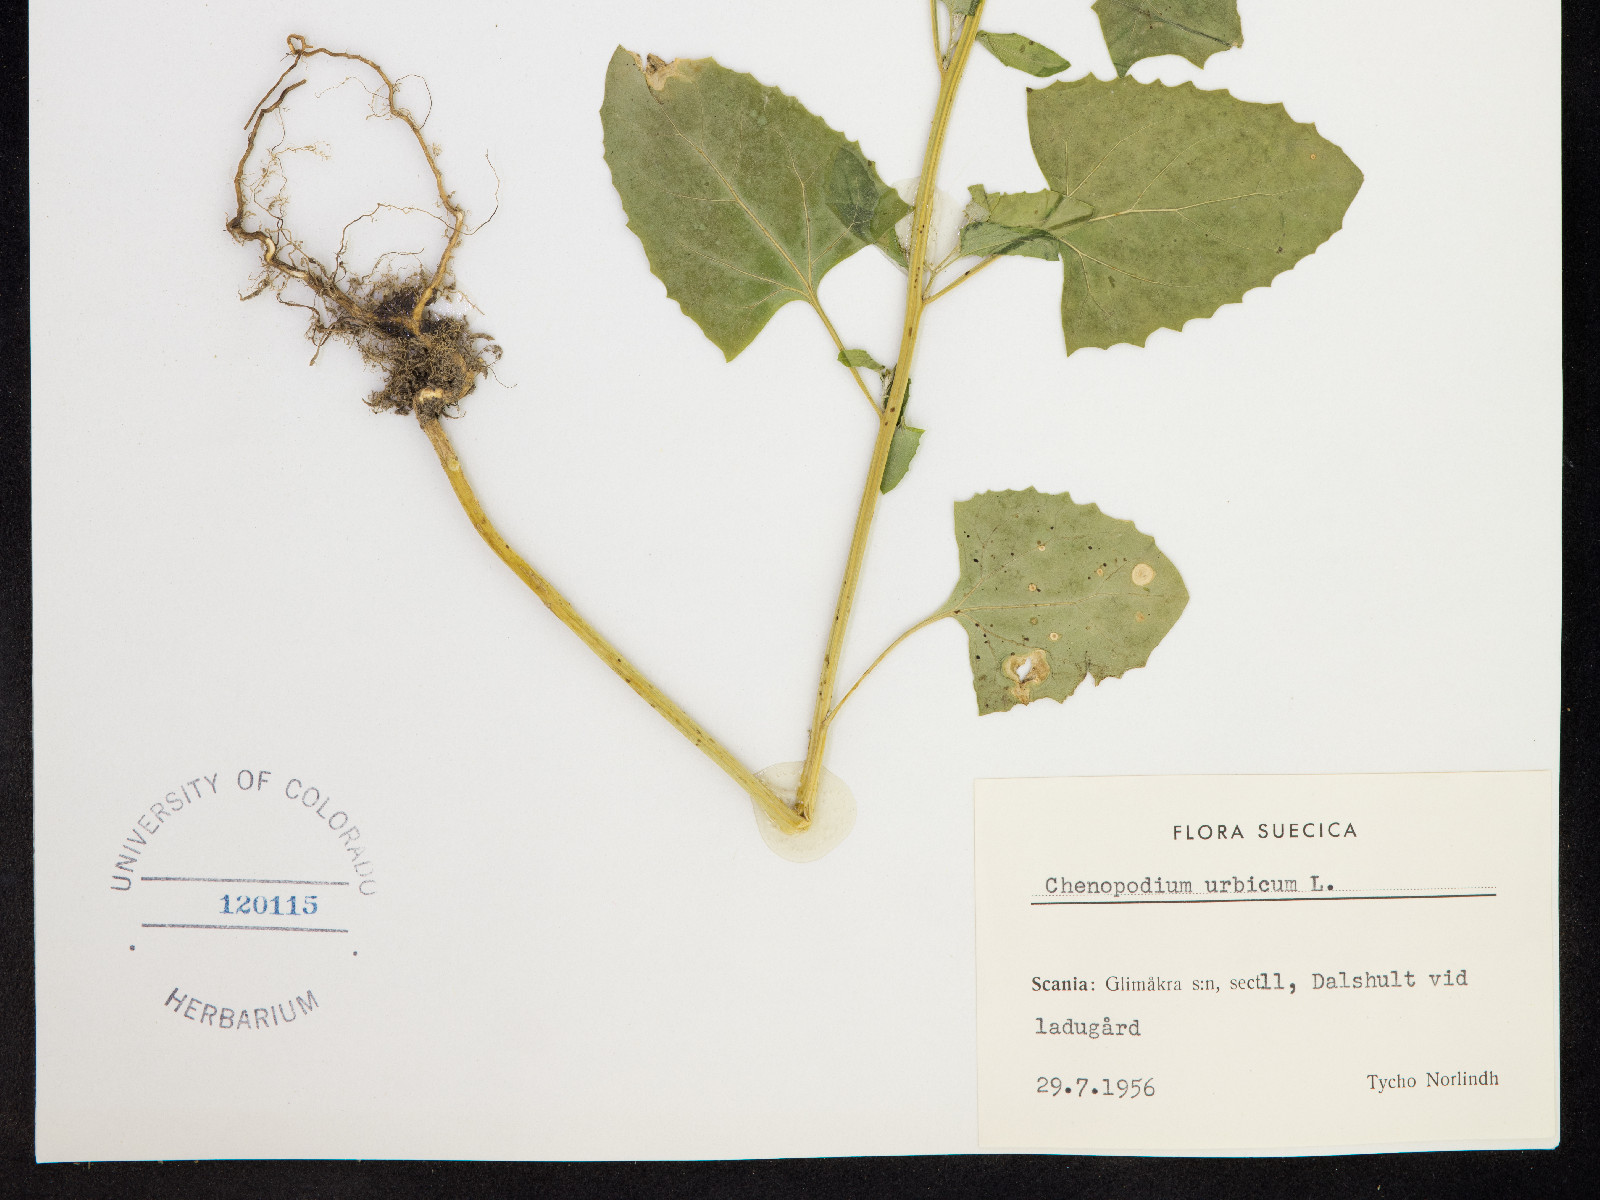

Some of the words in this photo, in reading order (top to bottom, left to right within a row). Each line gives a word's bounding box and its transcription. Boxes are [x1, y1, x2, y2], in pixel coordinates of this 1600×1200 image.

[110, 773, 218, 891] UNIVERSITY
[237, 769, 272, 791] OF
[1173, 824, 1245, 840] FLORA
[1258, 822, 1358, 839] SUECICA
[1045, 877, 1193, 897] Chenopodium
[1205, 876, 1298, 893] urbicum
[1309, 875, 1334, 892] L.
[219, 894, 319, 916] 120115
[1031, 976, 1095, 992] Scania:
[1105, 975, 1182, 992] Glimåkra
[1192, 977, 1220, 993] s:n,
[1312, 970, 1416, 990] Dalshult
[1429, 969, 1469, 987] vid
[164, 987, 320, 1030] HERBARIUM
[1035, 1016, 1142, 1039] ladugård
[1036, 1076, 1156, 1099] 29.7.1956
[1367, 1074, 1416, 1093] Tycho
[1426, 1070, 1500, 1087] Norlindh
